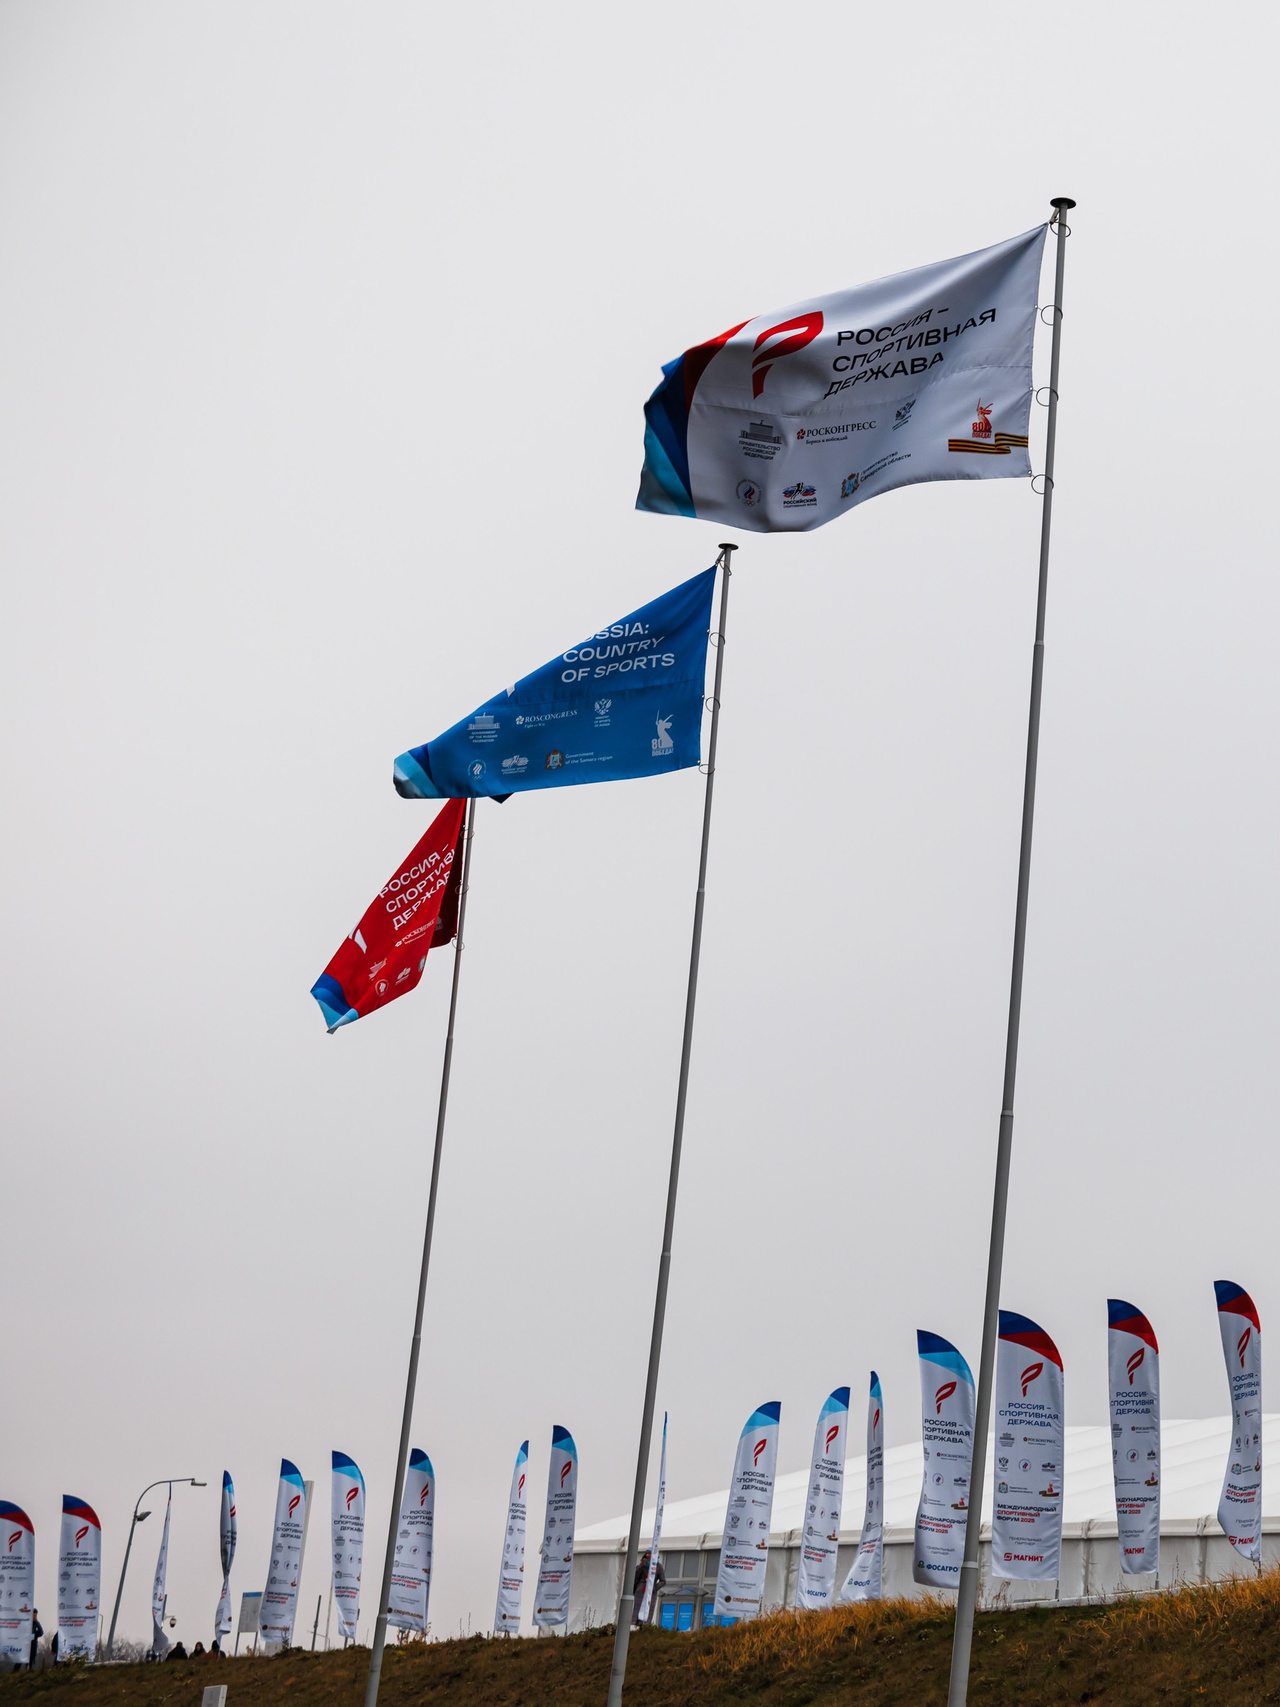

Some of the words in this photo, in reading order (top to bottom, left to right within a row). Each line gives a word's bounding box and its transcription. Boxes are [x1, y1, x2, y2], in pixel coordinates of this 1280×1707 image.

[837, 309, 933, 346] РОССИЯ
[832, 309, 996, 372] СПОРТИВНАЯ
[824, 352, 944, 399] ДЕРЖАВА
[807, 421, 876, 437] РОСКОНГРЕСС
[739, 441, 780, 451] ПРАВИТЕЛЬСТВО
[743, 447, 776, 456] РОССИЙСКОЙ
[744, 452, 773, 460] ФЕДЕРАЦИИ
[888, 454, 911, 465] области
[563, 636, 665, 663] COUNTRY
[561, 668, 591, 683] OF
[594, 653, 675, 679] SPORTS
[525, 709, 578, 723] ROSCONGRESS
[565, 751, 594, 759] Government
[379, 852, 440, 898] РОССИЯ
[386, 849, 455, 912] СПОРТИВ
[1008, 1402, 1044, 1410] РОССИЯ
[999, 1410, 1058, 1420] СПОРТИВНАЯ
[925, 1419, 957, 1427] РОССИЯ
[1008, 1419, 1051, 1428] ДЕРЖАВА
[925, 1434, 963, 1444] ДЕРЖАВА
[997, 1503, 1056, 1512] МЕЖДУНАРОДНЫЙ
[997, 1510, 1040, 1518] СПОРТИВНЫЙ
[1013, 1554, 1043, 1562] МАГНИТ
[926, 1563, 958, 1573] ФОСАГРО
